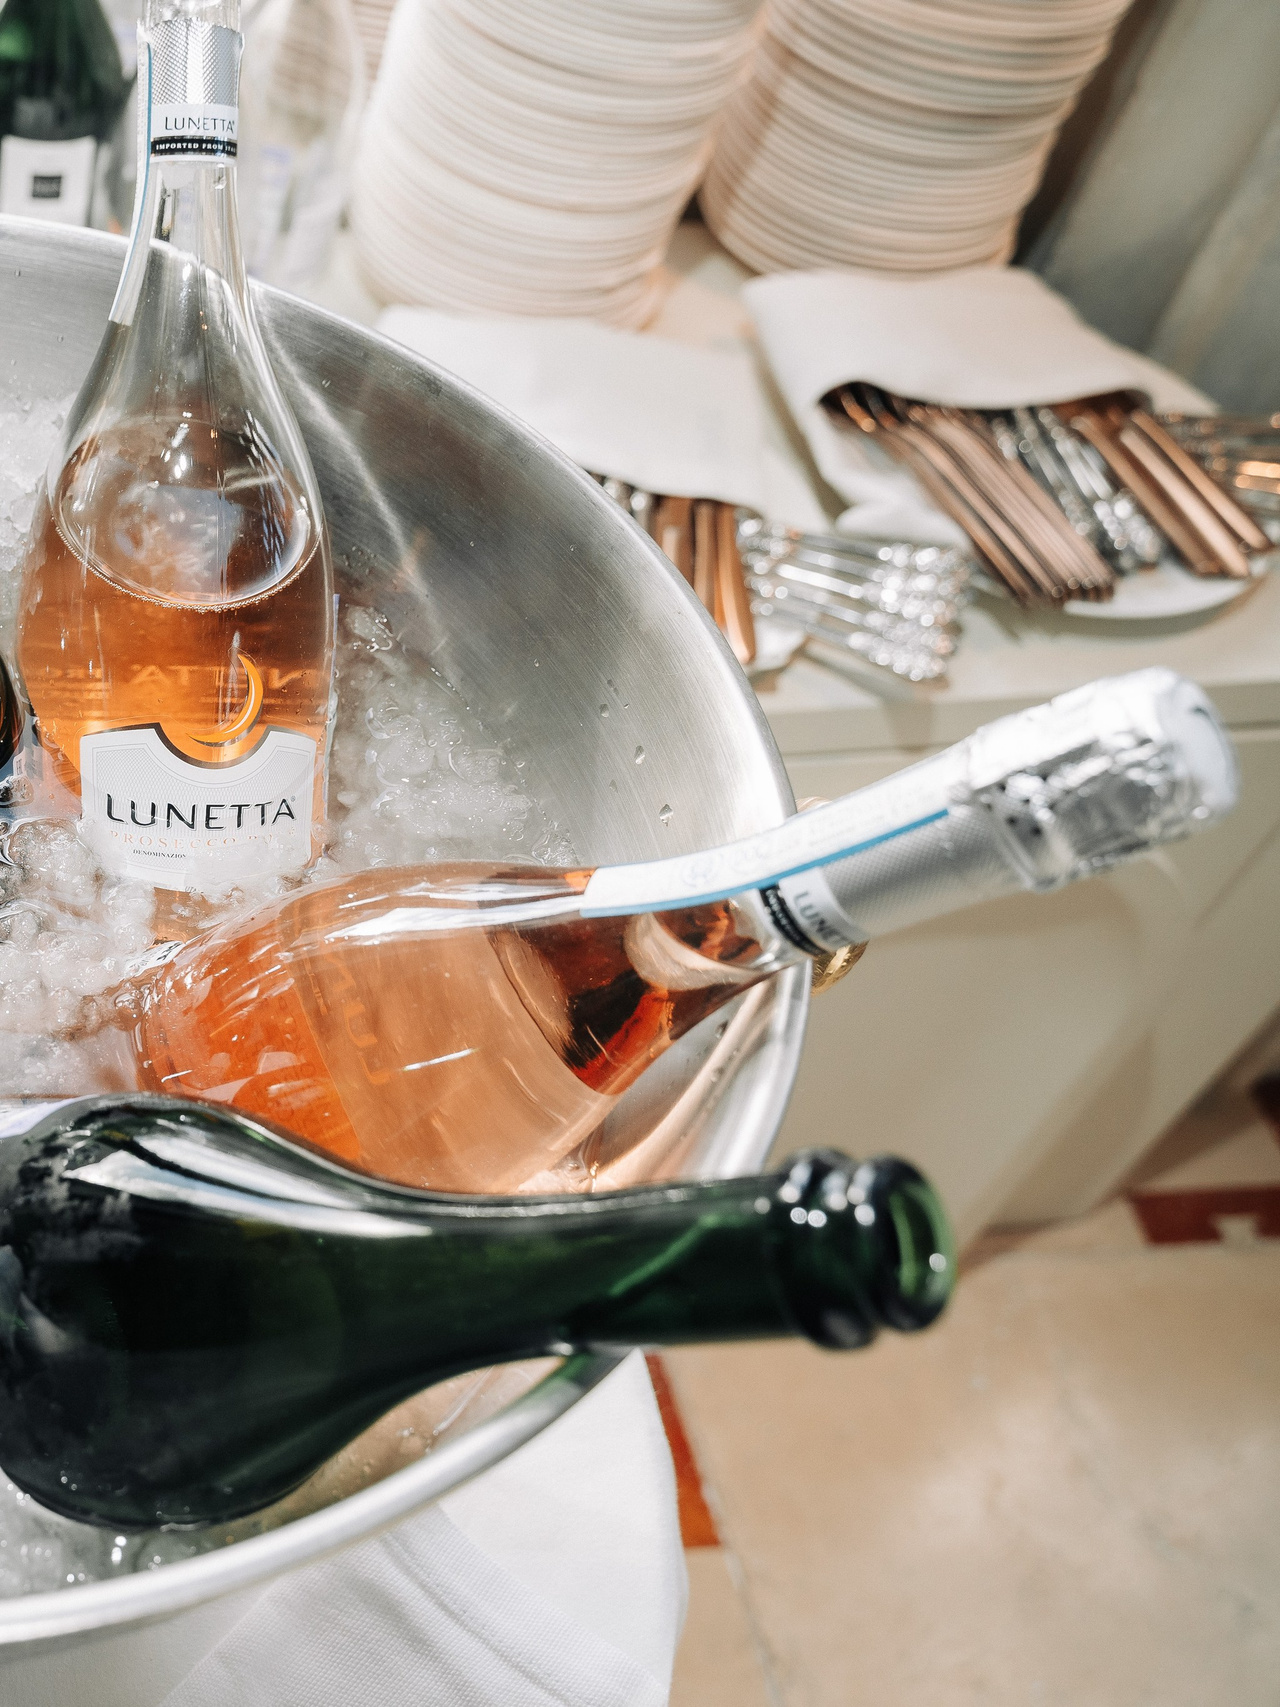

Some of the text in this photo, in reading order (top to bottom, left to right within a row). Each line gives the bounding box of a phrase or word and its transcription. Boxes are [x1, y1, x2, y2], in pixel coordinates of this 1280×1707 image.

[165, 117, 234, 134] LUNETTA
[156, 142, 199, 151] IMPORTED
[202, 142, 223, 151] FROM
[107, 793, 296, 830] LUNETTA
[132, 849, 187, 859] DENOMINAZION
